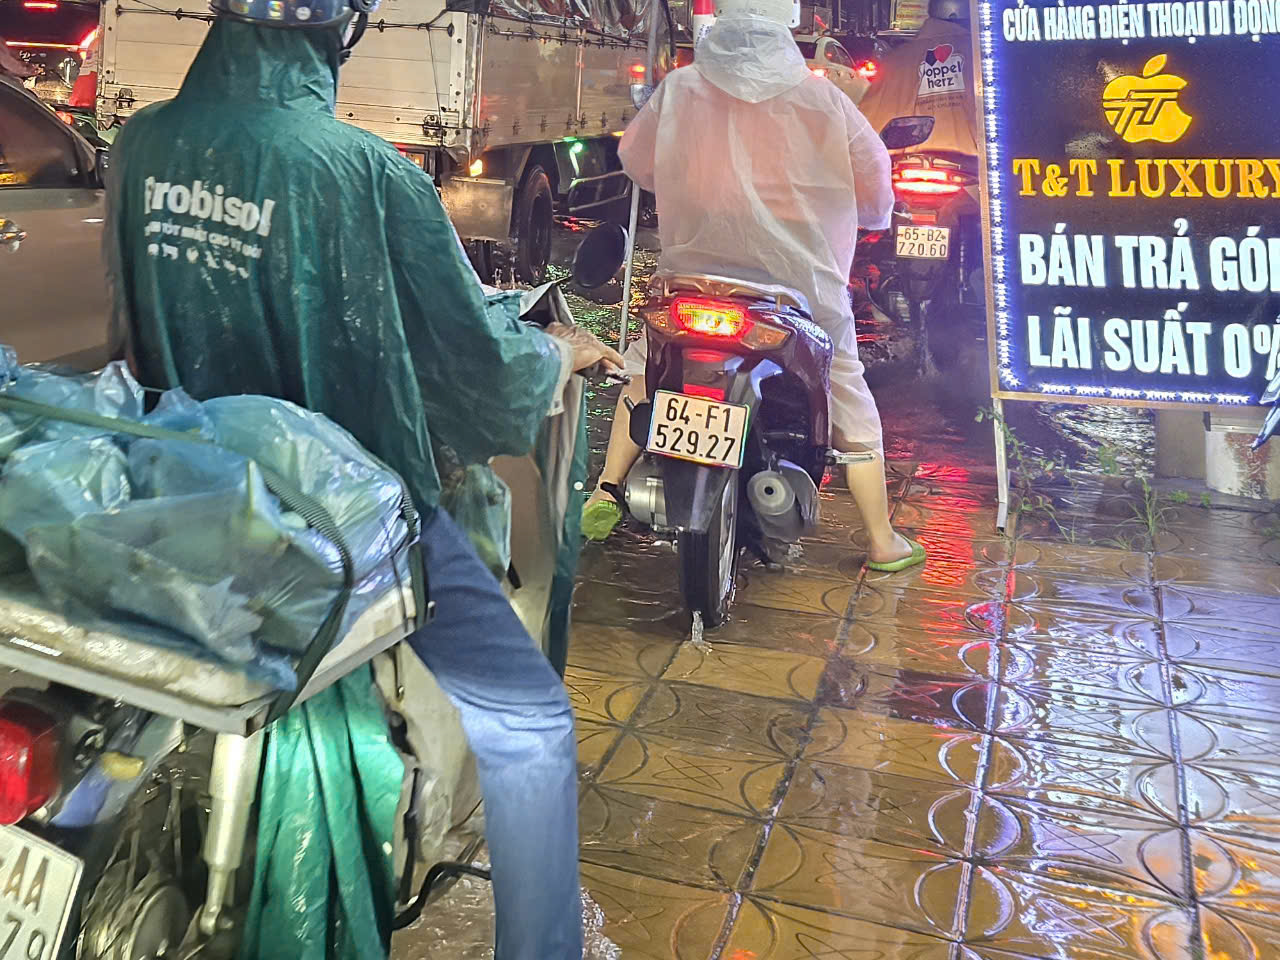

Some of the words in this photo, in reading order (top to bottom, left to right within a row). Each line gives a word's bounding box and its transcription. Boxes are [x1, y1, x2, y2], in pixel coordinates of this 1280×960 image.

[1044, 0, 1096, 40] HÀNG
[1147, 0, 1205, 44] THOẠI
[1208, 0, 1230, 36] DI
[927, 77, 954, 89] herz
[1013, 158, 1097, 198] T&T
[898, 242, 947, 256] 720.60
[1020, 223, 1106, 288] BÁN
[1114, 218, 1200, 290] TRẢ
[1027, 306, 1092, 369] LÃI
[1103, 301, 1212, 377] SUẤT
[666, 398, 731, 432] 64-F1
[655, 424, 735, 461] 529.27
